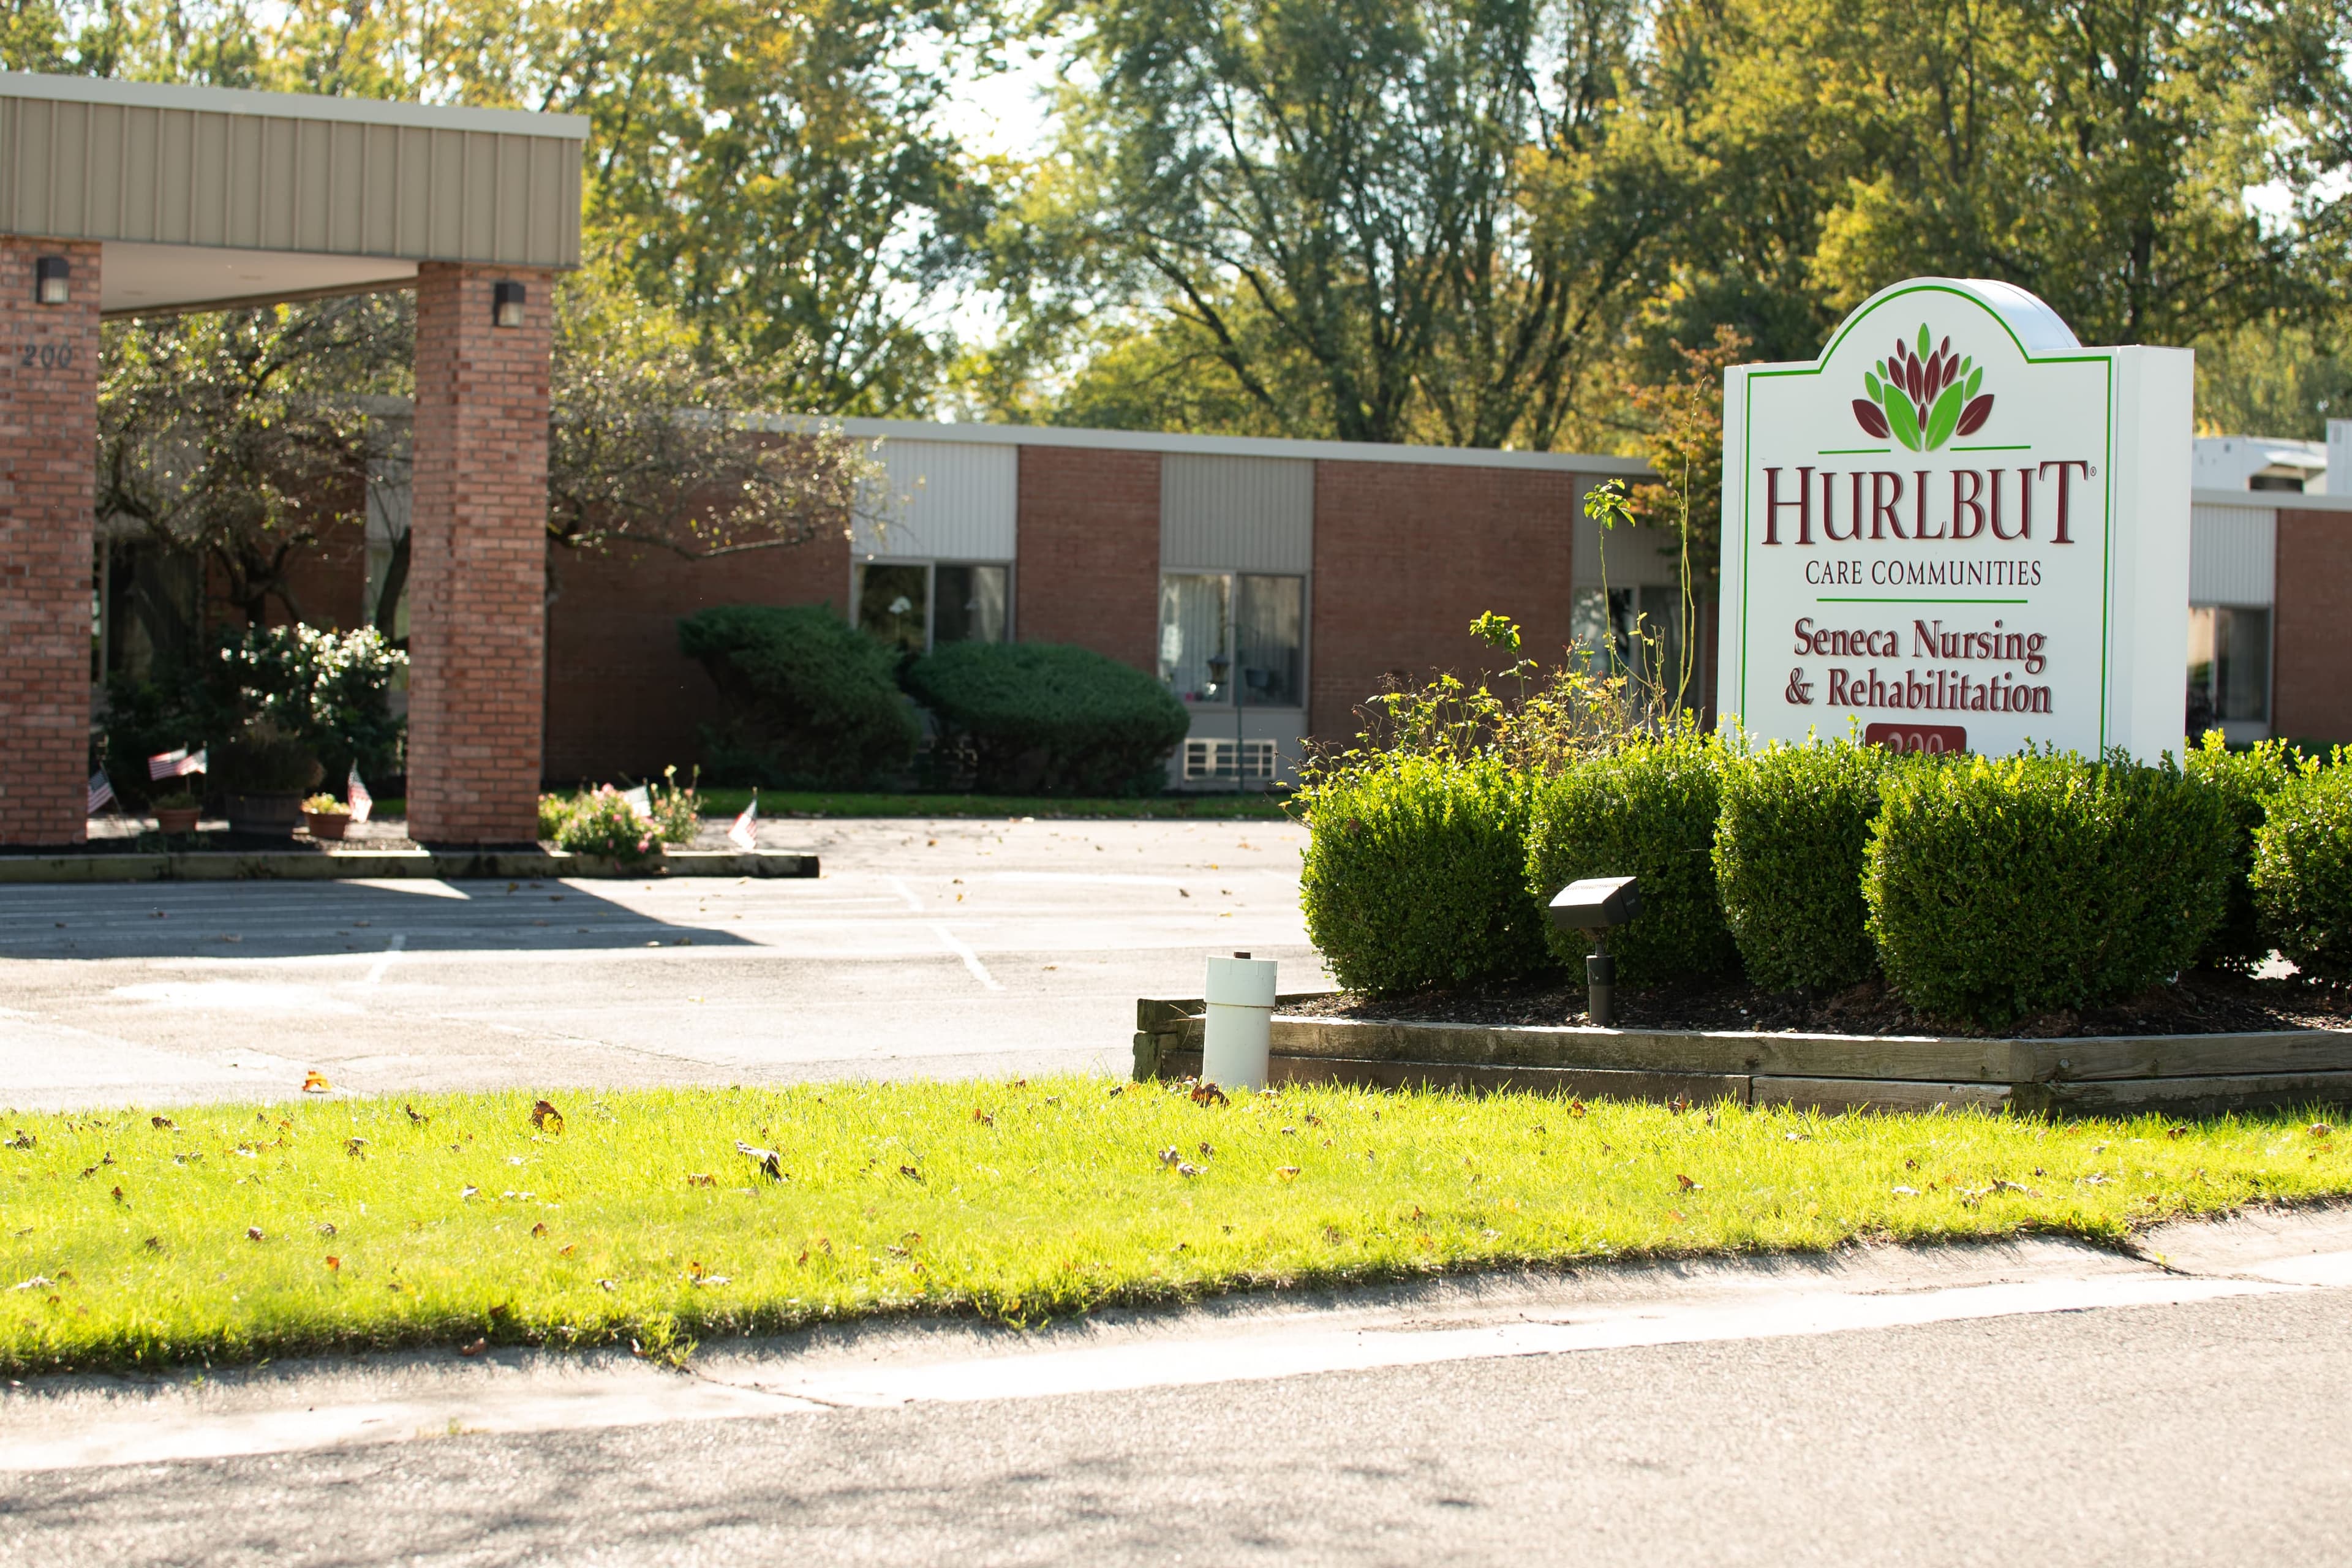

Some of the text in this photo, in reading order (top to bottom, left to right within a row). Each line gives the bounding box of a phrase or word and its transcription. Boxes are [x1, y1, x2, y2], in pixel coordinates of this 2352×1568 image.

[21, 344, 72, 368] 200
[1806, 560, 2041, 586] CARE COMMUNITIES
[1794, 617, 2047, 675] Seneca Nursing
[1785, 667, 2053, 714] & Rehabilitation
